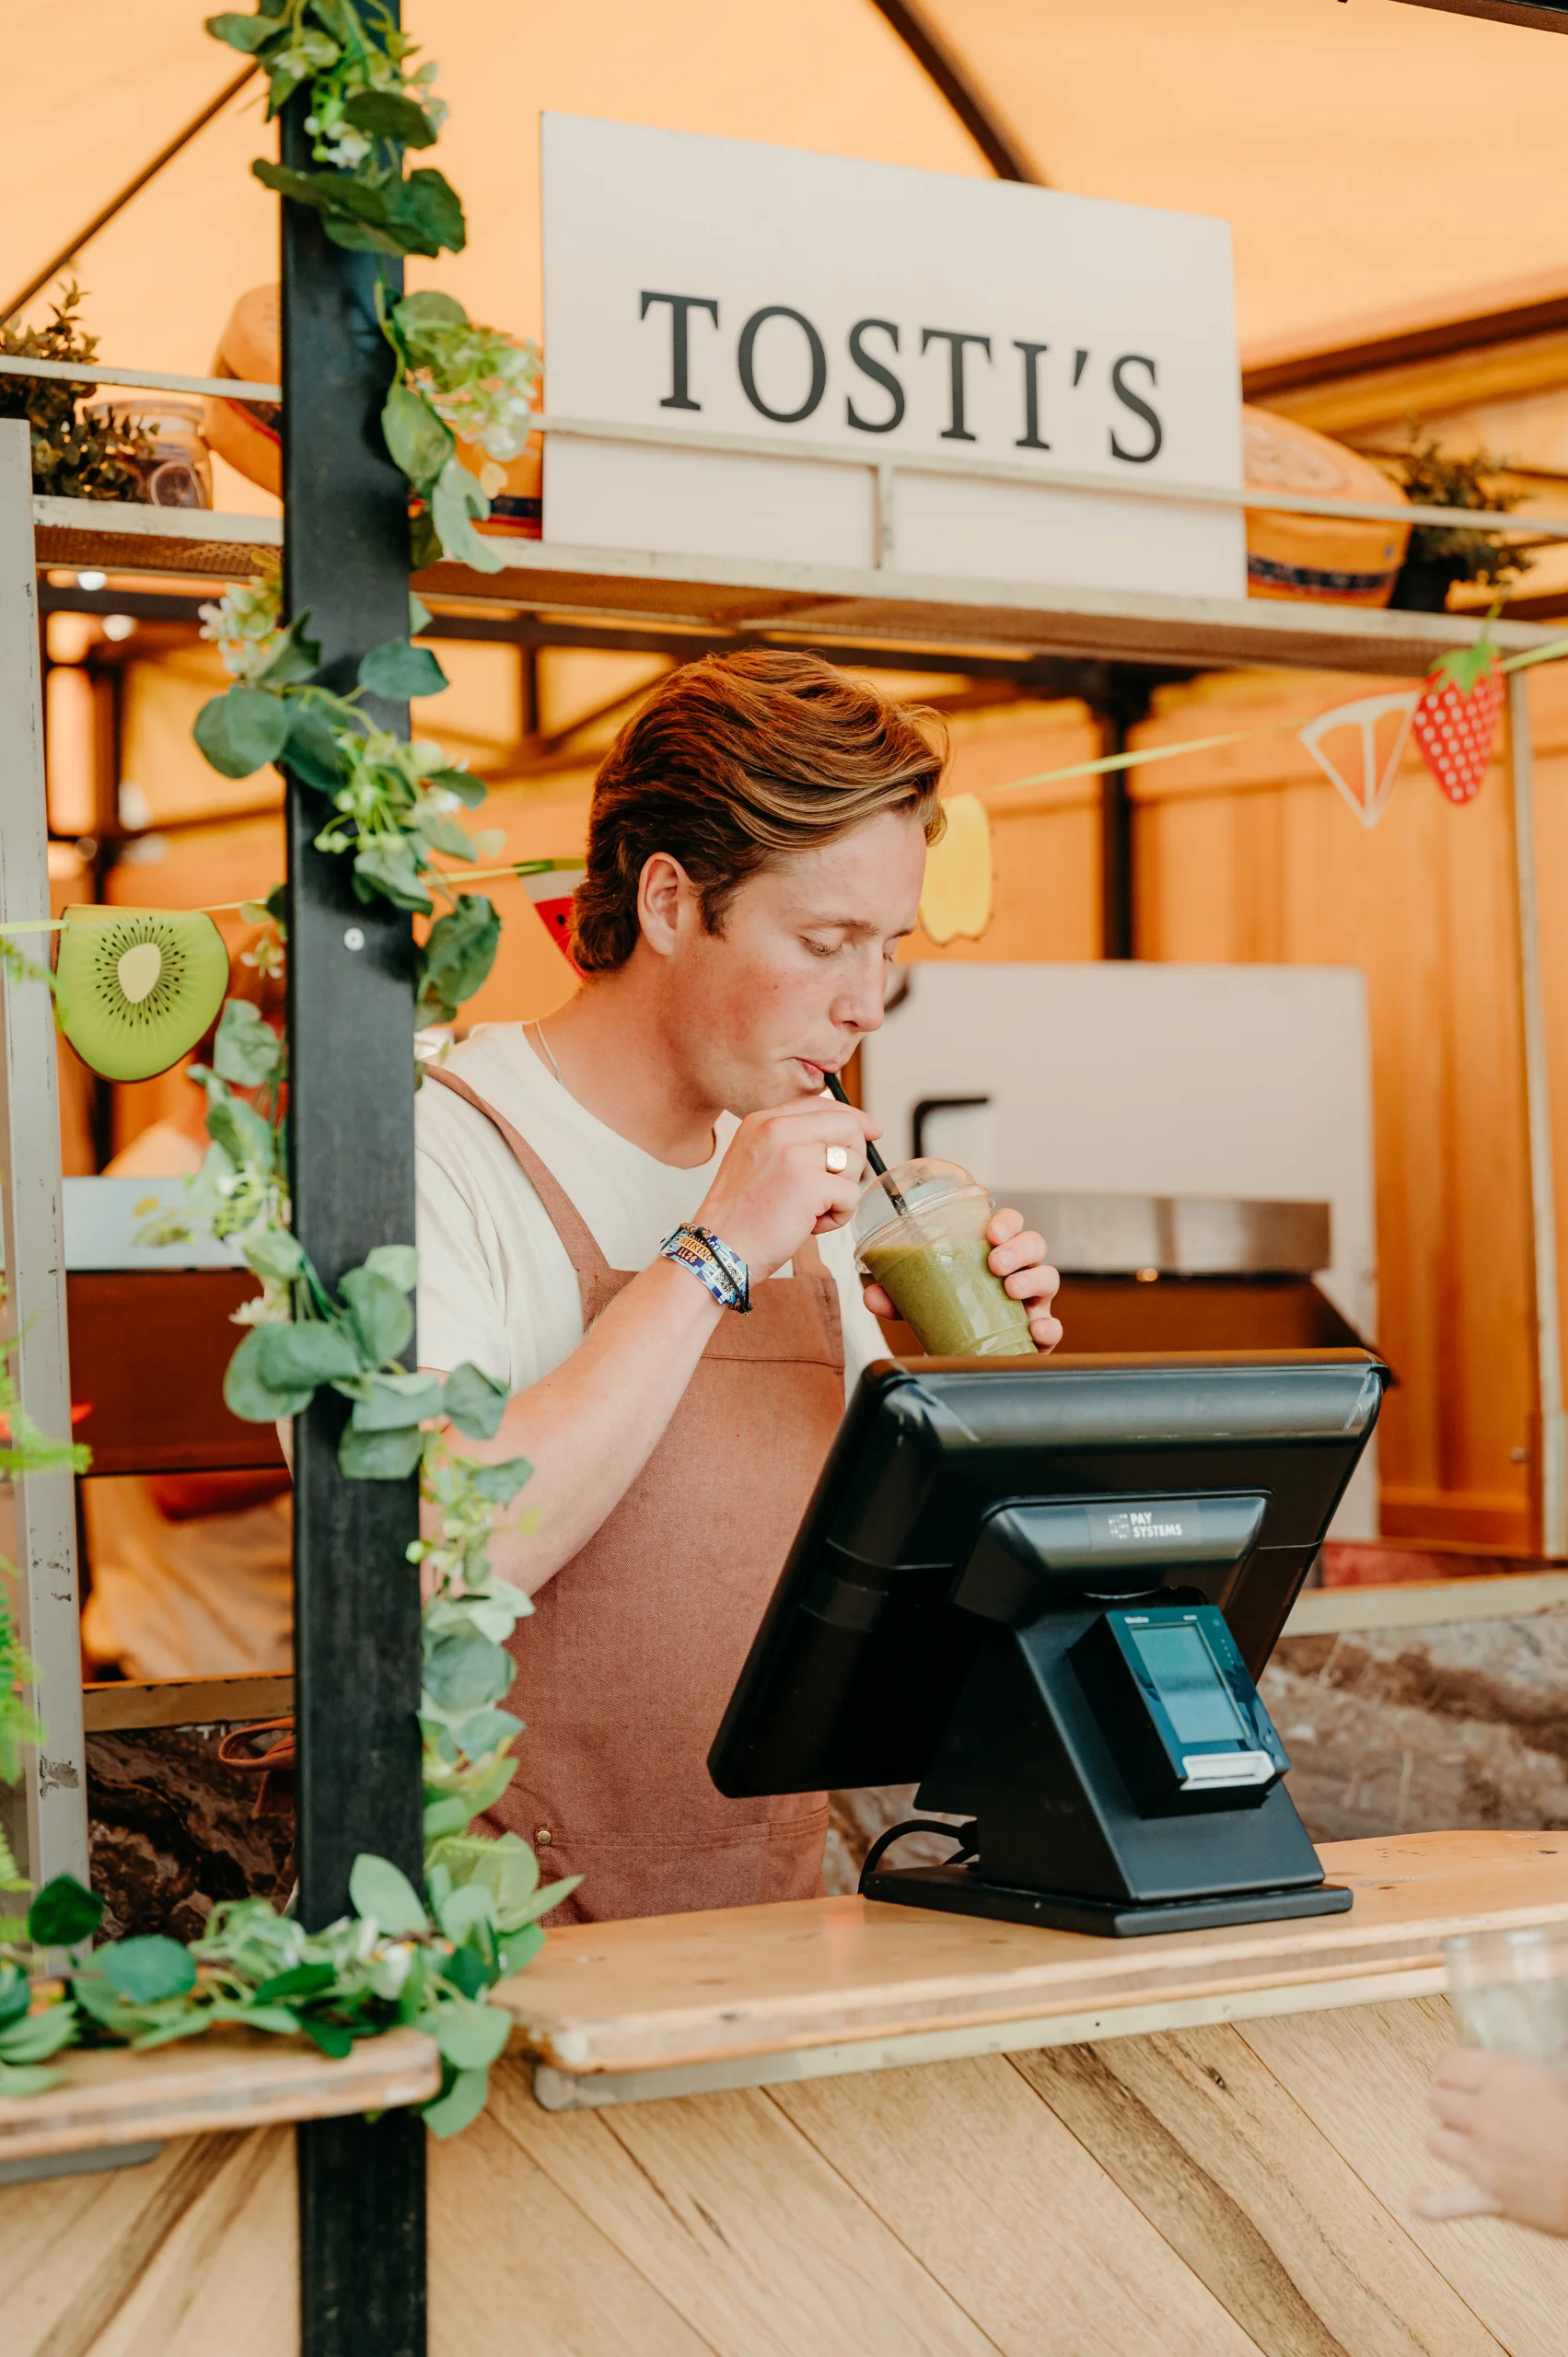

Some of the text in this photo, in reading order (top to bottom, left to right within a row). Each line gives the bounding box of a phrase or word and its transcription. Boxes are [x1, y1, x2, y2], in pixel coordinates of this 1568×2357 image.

[640, 290, 1163, 464] TOSTI'S
[679, 1236, 714, 1261] WEEKEND
[1129, 1512, 1153, 1526] PAY
[1132, 1524, 1182, 1538] SYSTEMS
